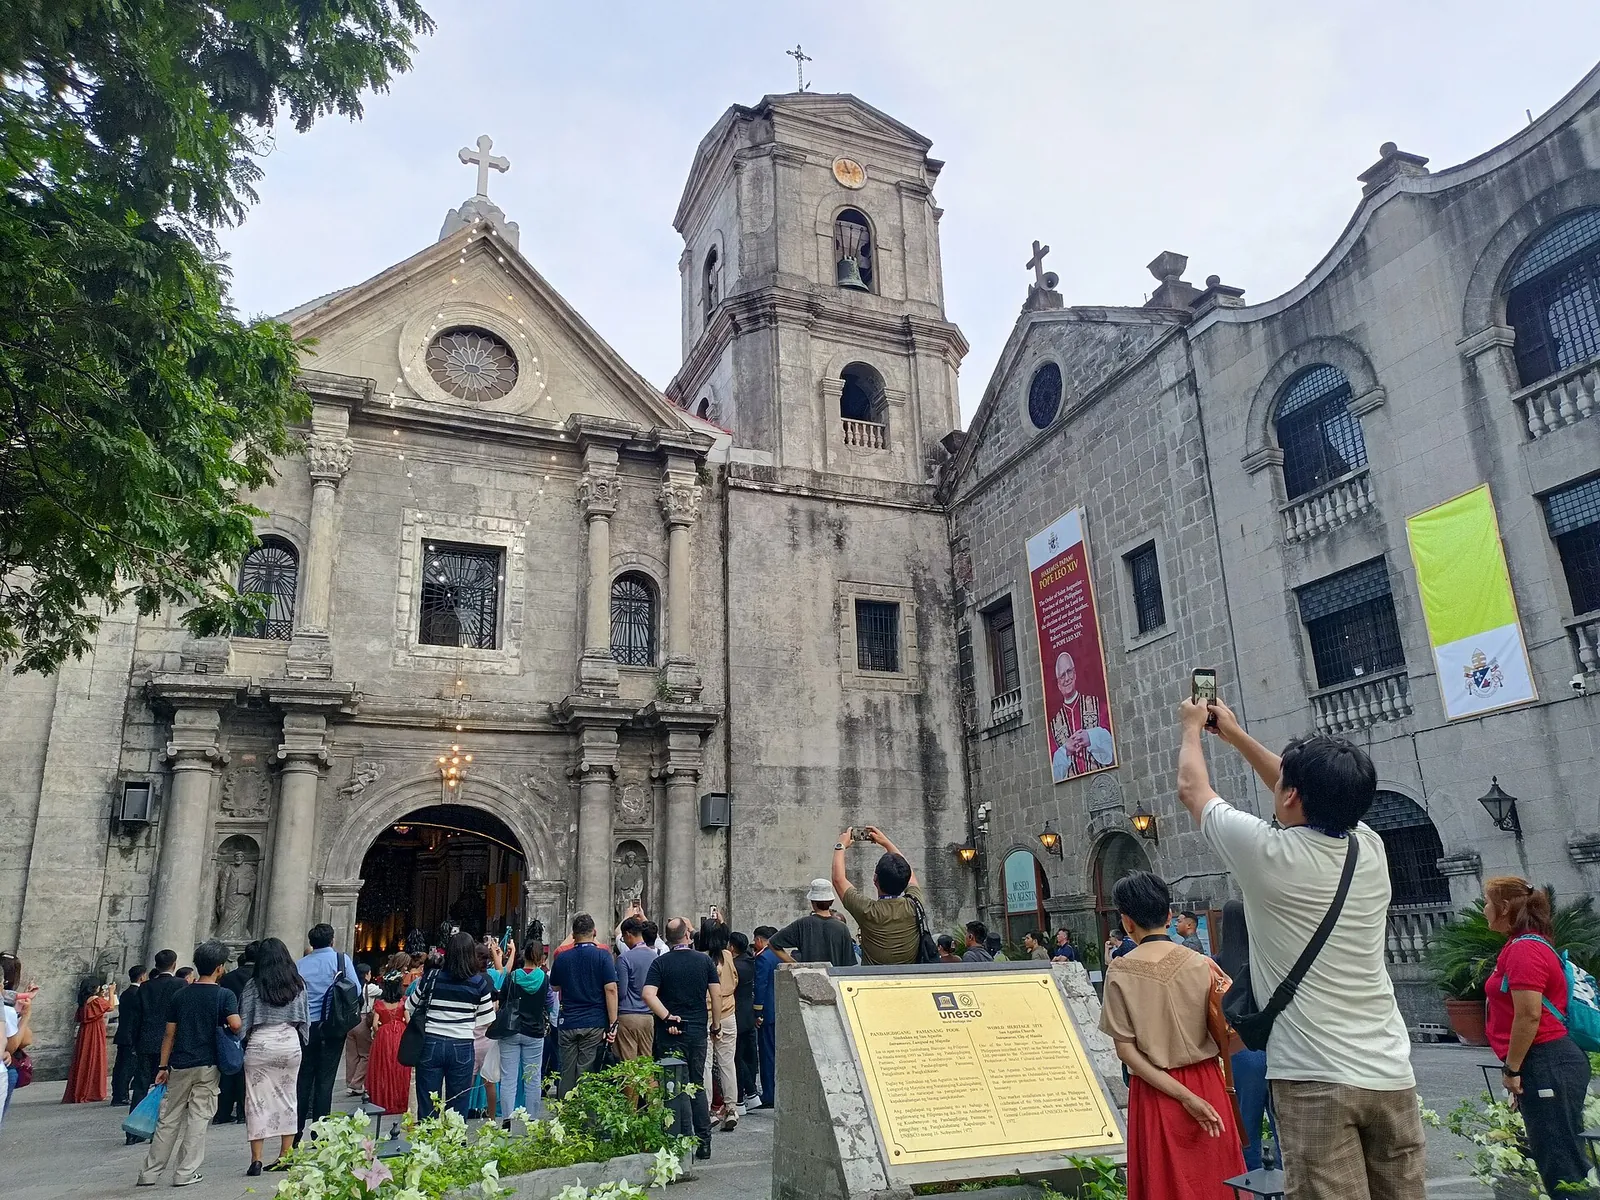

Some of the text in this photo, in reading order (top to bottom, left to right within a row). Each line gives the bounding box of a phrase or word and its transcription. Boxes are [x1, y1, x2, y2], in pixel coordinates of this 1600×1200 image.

[1039, 559, 1078, 590] POPE LEO XIV
[1012, 880, 1030, 892] MUSEO
[1008, 891, 1036, 902] SAN AGUSTIN
[939, 1010, 982, 1019] unesco
